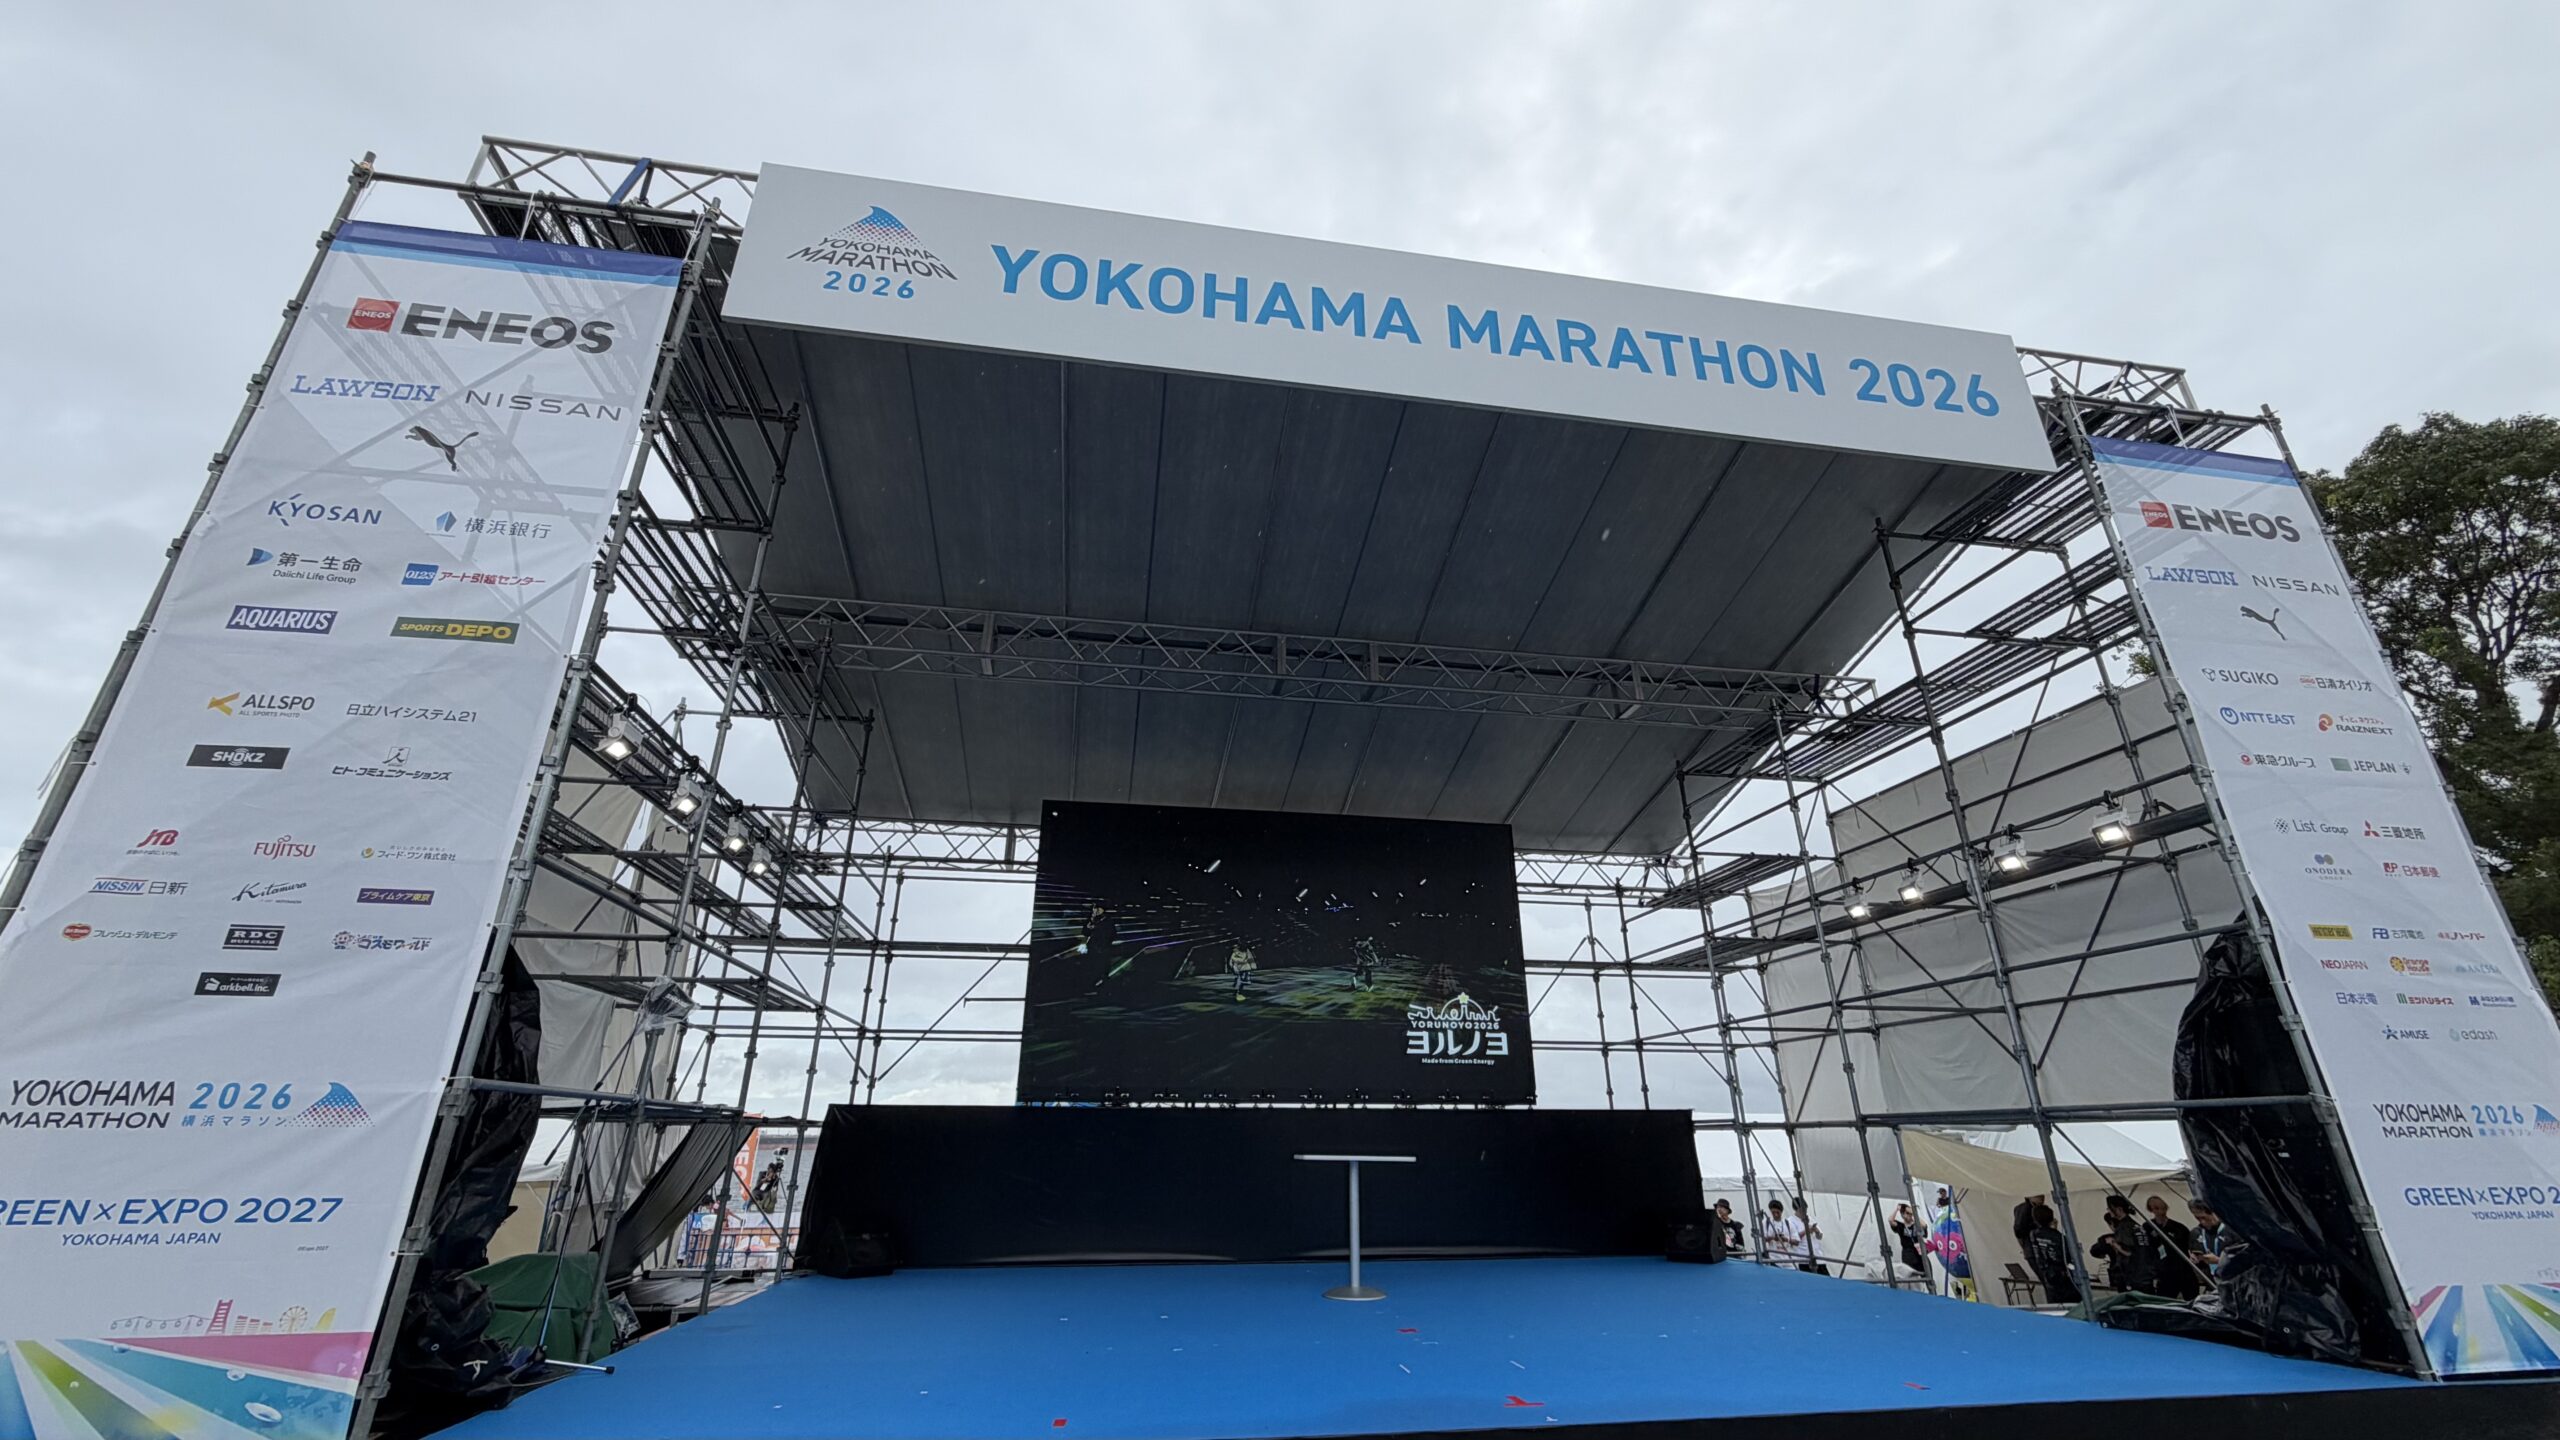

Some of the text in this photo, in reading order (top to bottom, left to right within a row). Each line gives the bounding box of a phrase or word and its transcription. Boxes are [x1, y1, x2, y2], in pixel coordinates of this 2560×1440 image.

[820, 236, 939, 262] YOKOHAMA
[786, 246, 958, 281] MARATHON
[822, 270, 915, 300] 2026
[354, 308, 392, 321] ENEOS
[401, 303, 615, 354] ENEOS
[991, 244, 2000, 417] YOKOHAMA MARATHON 2026
[290, 375, 440, 402] LAWSON
[465, 389, 622, 422] NISSAN
[268, 493, 382, 526] KYOSAN
[464, 517, 552, 540] 横浜銀行
[2171, 503, 2301, 543] ENEOS
[276, 551, 363, 573] 第一生命
[273, 569, 357, 585] Daiichi Life Group
[405, 569, 436, 581] 0123
[438, 570, 547, 587] アート引越センター
[2145, 566, 2239, 586] LAWSON
[2252, 574, 2340, 596] NISSAN
[231, 607, 333, 631] AQUARIUS
[400, 622, 513, 640] SPORTS DEPO
[2219, 669, 2279, 686] SUGIKO
[241, 694, 315, 711] ALLSPO
[346, 704, 477, 722] 日立ハイシステム21
[2239, 712, 2296, 725] NTT EAST
[2336, 724, 2393, 735] RAIZNEXT
[211, 750, 266, 763] SHOKZ
[332, 766, 453, 781] ヒト・コミュニケーションズ
[2353, 760, 2397, 773] JEPLAN
[2292, 819, 2349, 836] List Group
[2380, 826, 2426, 840] 三菱地所
[136, 829, 179, 848] JTB
[253, 835, 316, 860] FUJITSU
[2401, 865, 2441, 878] 日本郵便
[95, 881, 145, 892] NISSIN
[148, 882, 189, 896] 日新
[231, 881, 308, 902] Kitamura
[361, 891, 431, 902] プライムケア東京
[94, 928, 179, 941] フレッシュ・デルモンテ
[231, 930, 278, 939] RDC
[357, 938, 431, 951] コスモワールド
[2320, 959, 2369, 971] NEOJAPAN
[2335, 992, 2378, 1005] 日本光電
[1406, 1029, 1509, 1056] ヨルノヨ
[2400, 1030, 2430, 1040] AMUSE
[10, 1079, 175, 1107] YOKOHAMA
[188, 1082, 293, 1110] 2026
[0, 1112, 170, 1129] MARATHON
[181, 1114, 288, 1127] 横浜マラソン
[2373, 1104, 2468, 1123] YOKOHAMA
[2471, 1105, 2525, 1125] 2026
[2381, 1126, 2474, 1139] MARATHON
[234, 1197, 344, 1224] 2027
[2471, 1211, 2555, 1220] YOKOHAMA JAPAN
[61, 1232, 221, 1247] YOKOHAMA JAPAN
